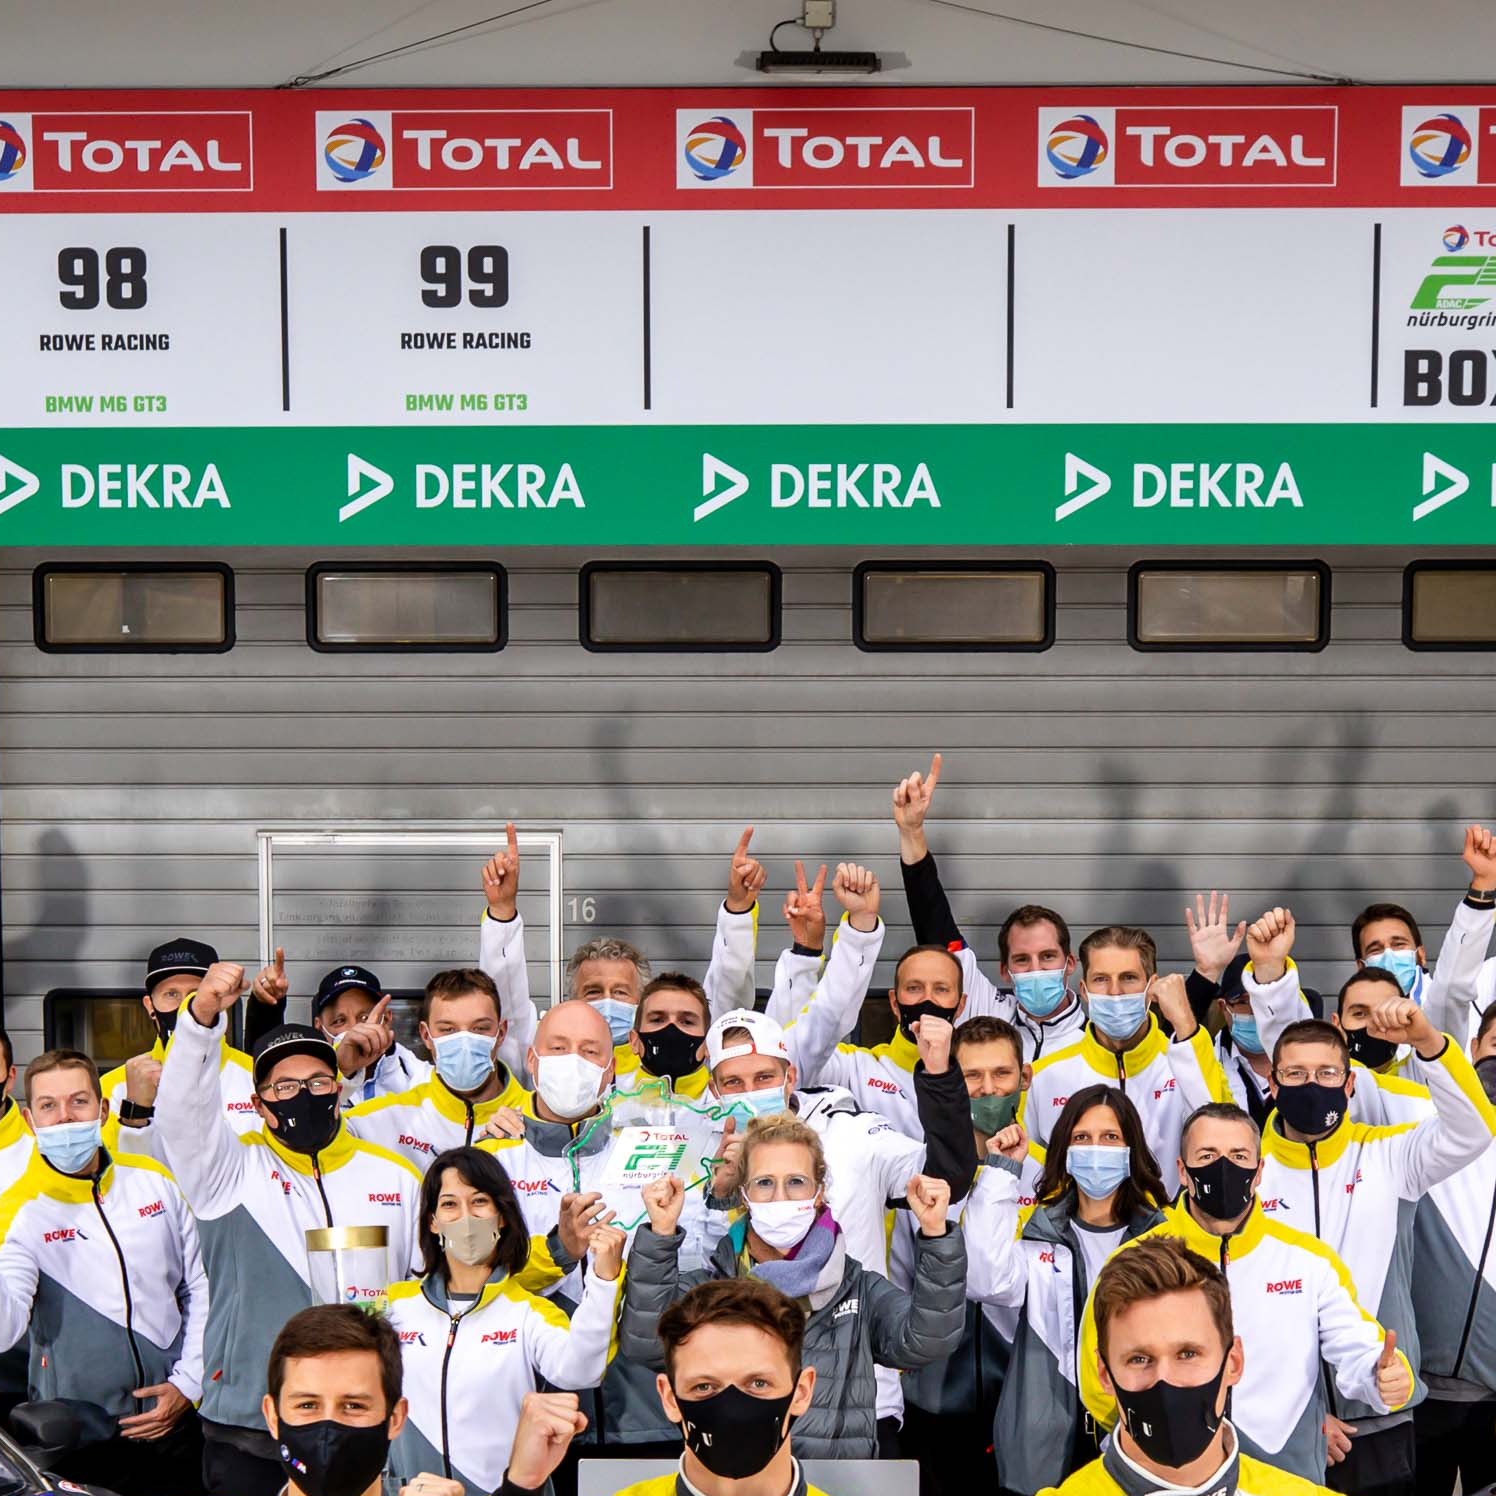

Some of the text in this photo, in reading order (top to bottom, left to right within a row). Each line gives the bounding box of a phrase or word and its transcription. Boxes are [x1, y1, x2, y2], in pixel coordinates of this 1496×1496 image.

[44, 132, 242, 172] TOTAL
[403, 130, 601, 170] TOTAL
[764, 128, 963, 168] TOTAL
[1126, 126, 1326, 167] TOTAL
[58, 247, 147, 309] 98
[420, 246, 508, 308] 99
[39, 334, 170, 352] ROWE RACING
[400, 332, 531, 350] ROWE RACING
[45, 395, 167, 413] BMW M6 GT3
[406, 394, 527, 411] BMW M6 GT3
[61, 463, 231, 508] DEKRA
[416, 463, 586, 508] DEKRA
[771, 463, 941, 508] DEKRA
[1133, 463, 1304, 508] DEKRA
[568, 897, 597, 922] 16
[398, 1135, 431, 1152] ROWE
[368, 1192, 401, 1204] ROWE
[43, 1228, 76, 1243] ROWE
[1266, 1279, 1303, 1294] ROWE
